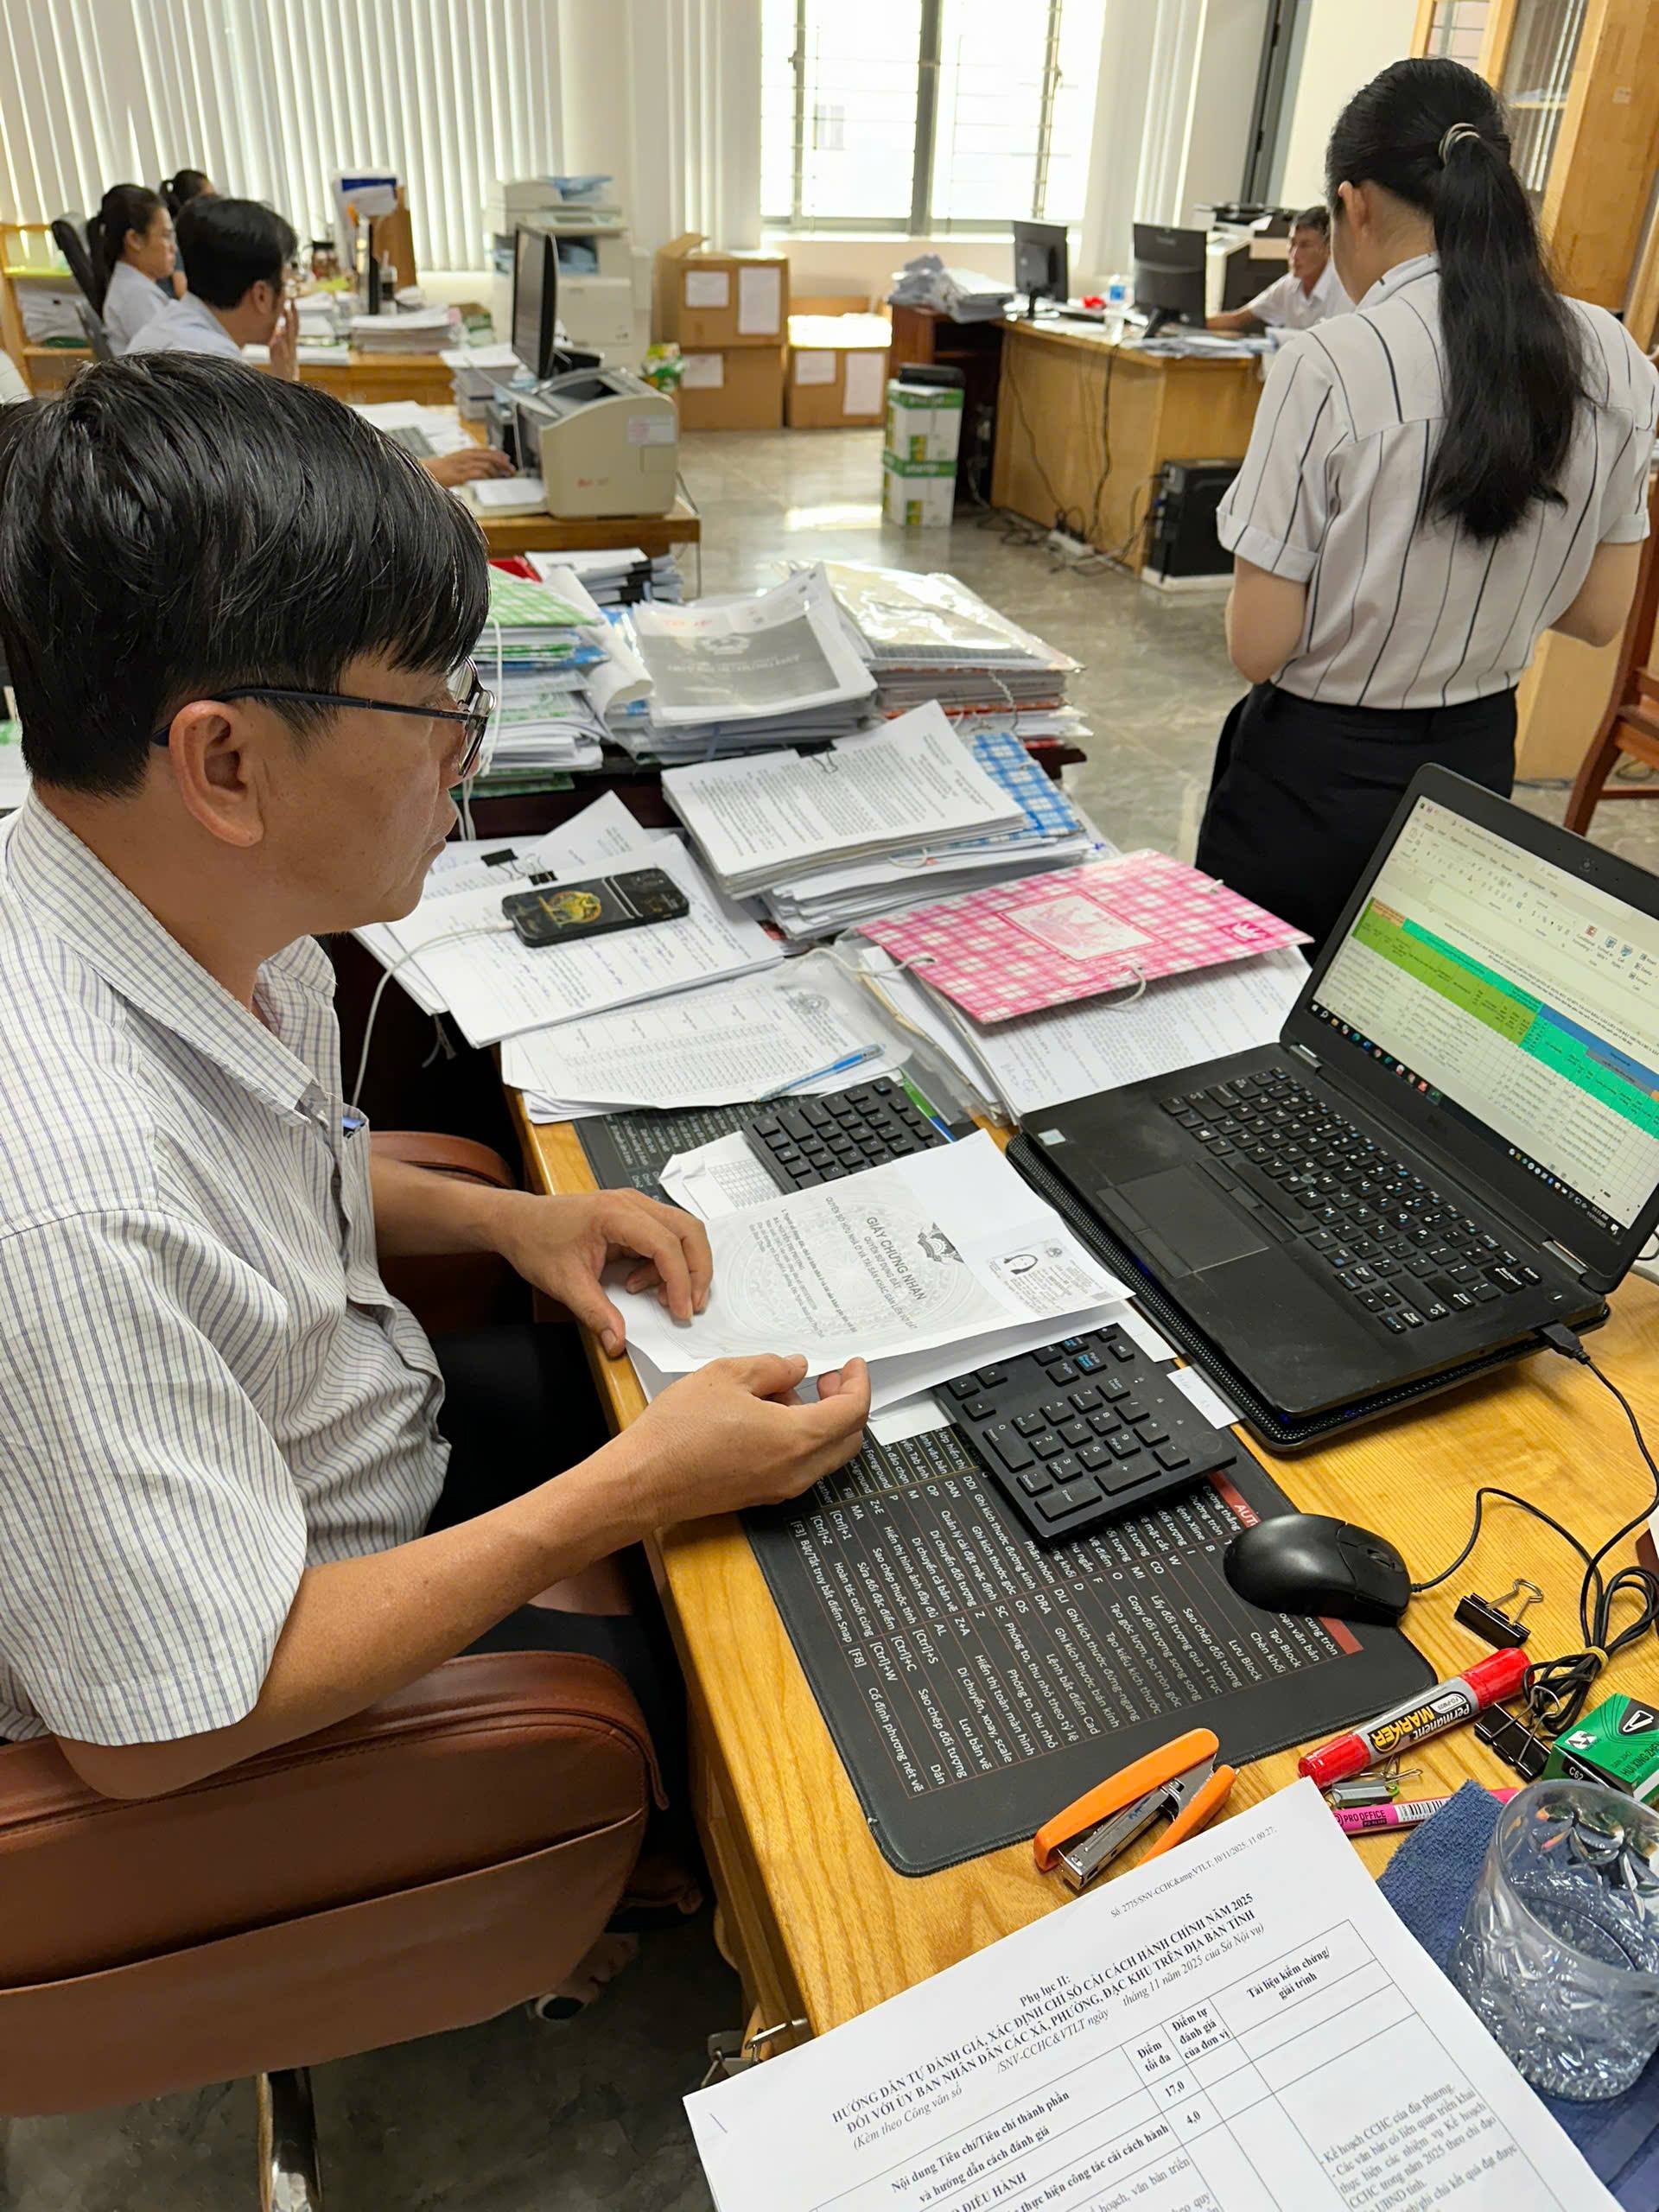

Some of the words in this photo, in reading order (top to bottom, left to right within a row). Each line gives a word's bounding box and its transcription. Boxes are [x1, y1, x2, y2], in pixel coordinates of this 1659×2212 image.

[865, 1216, 888, 1238] GIẤY
[880, 1239, 909, 1274] CHỨNG
[900, 1273, 928, 1301] NHẬN
[790, 1520, 808, 1538] [F3]
[810, 1515, 834, 1547] [Ctrl]+Z
[829, 1509, 853, 1541] [Ctrl]+1
[799, 1539, 821, 1568] Bật/Tắt
[812, 1567, 827, 1585] truy
[833, 1561, 849, 1585] Hoàn
[856, 1561, 871, 1579] Sửa
[820, 1584, 836, 1600] bắt
[843, 1583, 856, 1599] tác
[864, 1578, 880, 1593] đổi
[827, 1599, 843, 1622] điểm
[849, 1597, 867, 1616] cuối
[871, 1592, 886, 1609] đặc
[858, 1615, 875, 1638] cùng
[879, 1608, 896, 1631] điểm
[836, 1620, 853, 1643] Snap
[847, 1647, 868, 1669] [F8]
[890, 1635, 918, 1673] [Ctrl]+C
[868, 1687, 884, 1701] Cố
[917, 1688, 932, 1707] Sao
[868, 1641, 899, 1681] [Ctrl]+W
[930, 1763, 946, 1785] Dán
[874, 1700, 892, 1723] định
[926, 1706, 944, 1730] chép
[1413, 1703, 1470, 1740] Permanent
[1371, 1706, 1434, 1747] MARKER
[881, 1722, 908, 1763] phương
[938, 1730, 956, 1747] đối
[901, 1761, 918, 1780] nét
[946, 1746, 969, 1779] tượng
[1569, 1766, 1584, 1781] C62
[910, 1778, 925, 1793] vẽ
[1344, 1814, 1359, 1822] PRO
[1359, 1810, 1386, 1821] OFFICE
[1245, 1983, 1265, 1999] Tài
[1262, 1976, 1281, 1991] liệu
[1278, 1964, 1302, 1981] kiểm
[1301, 1946, 1331, 1969] chứng/
[1019, 1992, 1041, 2008] Phụ
[1039, 1983, 1057, 1997] lục
[1056, 1974, 1071, 1988] II:
[1278, 1982, 1296, 2001] giải
[1294, 1972, 1319, 1990] trình
[831, 2091, 880, 2124] HƯỚNG
[906, 2065, 925, 2084] TỰ
[925, 2049, 962, 2075] ĐÁNH
[961, 2035, 989, 2056] GIÁ,
[986, 2021, 1012, 2043] XÁC
[1013, 2005, 1045, 2029] ĐỊNH
[1044, 1991, 1067, 2012] CHỈ
[1065, 1983, 1084, 2001] SỐ
[1083, 1973, 1105, 1991] CẢI
[1104, 1955, 1138, 1980] CÁCH
[1135, 1937, 1171, 1962] HÀNH
[1169, 1918, 1207, 1944] CHÍNH
[1205, 1904, 1232, 1925] NĂM
[1230, 1892, 1254, 1912] 2025
[1171, 2013, 1198, 2032] Điểm
[1196, 2007, 1208, 2018] tự
[846, 2113, 871, 2134] ĐỐI
[870, 2101, 896, 2120] VỚI
[895, 2090, 913, 2108] ỦY
[914, 2076, 942, 2099] BAN
[941, 2058, 977, 2084] NHÂN
[976, 2044, 1004, 2066] DÂN
[1003, 2031, 1028, 2051] CÁC
[1028, 2019, 1052, 2038] XÃ,
[1049, 1993, 1104, 2027] PHƯỜNG,
[1101, 1978, 1126, 1999] ĐẶC
[1126, 1966, 1152, 1986] KHU
[1152, 1948, 1185, 1971] TRÊN
[1182, 1938, 1205, 1955] ĐỊA
[1203, 1923, 1229, 1944] BÀN
[1225, 1909, 1255, 1930] TỈNH
[1179, 2026, 1204, 2045] đánh
[1202, 2018, 1217, 2035] giá
[853, 2130, 880, 2151] (Kèm
[880, 2118, 903, 2136] theo
[903, 2103, 932, 2123] Công
[931, 2093, 950, 2108] văn
[950, 2080, 963, 2100] số
[997, 2018, 1085, 2075] /SNV-CCHC&VTLT
[1082, 2008, 1109, 2027] ngày
[1122, 1987, 1151, 2007] tháng
[1148, 1977, 1160, 1993] 11
[1161, 1969, 1182, 1986] năm
[1180, 1954, 1204, 1975] 2025
[1204, 1948, 1222, 1962] của
[1219, 1939, 1234, 1954] Sở
[1232, 1930, 1250, 1947] Nội
[1249, 1922, 1265, 1936] vụ)
[1184, 2046, 1202, 2060] của
[1200, 2036, 1220, 2050] đơn
[1218, 2028, 1231, 2040] vị
[1136, 2042, 1163, 2060] Điểm
[1144, 2057, 1160, 2073] tối
[1158, 2054, 1172, 2065] đa
[1164, 2080, 1185, 2098] 17,0
[1186, 2110, 1201, 2125] 4,0
[890, 2175, 912, 2194] Nội
[911, 2163, 939, 2183] dung
[936, 2151, 962, 2167] Tiêu
[961, 2129, 1001, 2155] chí/Tiêu
[1001, 2118, 1018, 2134] chí
[1016, 2104, 1046, 2126] thành
[1045, 2090, 1071, 2113] phần
[918, 2190, 933, 2203] và
[931, 2173, 967, 2196] hướng
[965, 2161, 986, 2178] dẫn
[986, 2148, 1009, 2167] cách
[1009, 2134, 1035, 2154] đánh
[1034, 2125, 1051, 2143] giá
